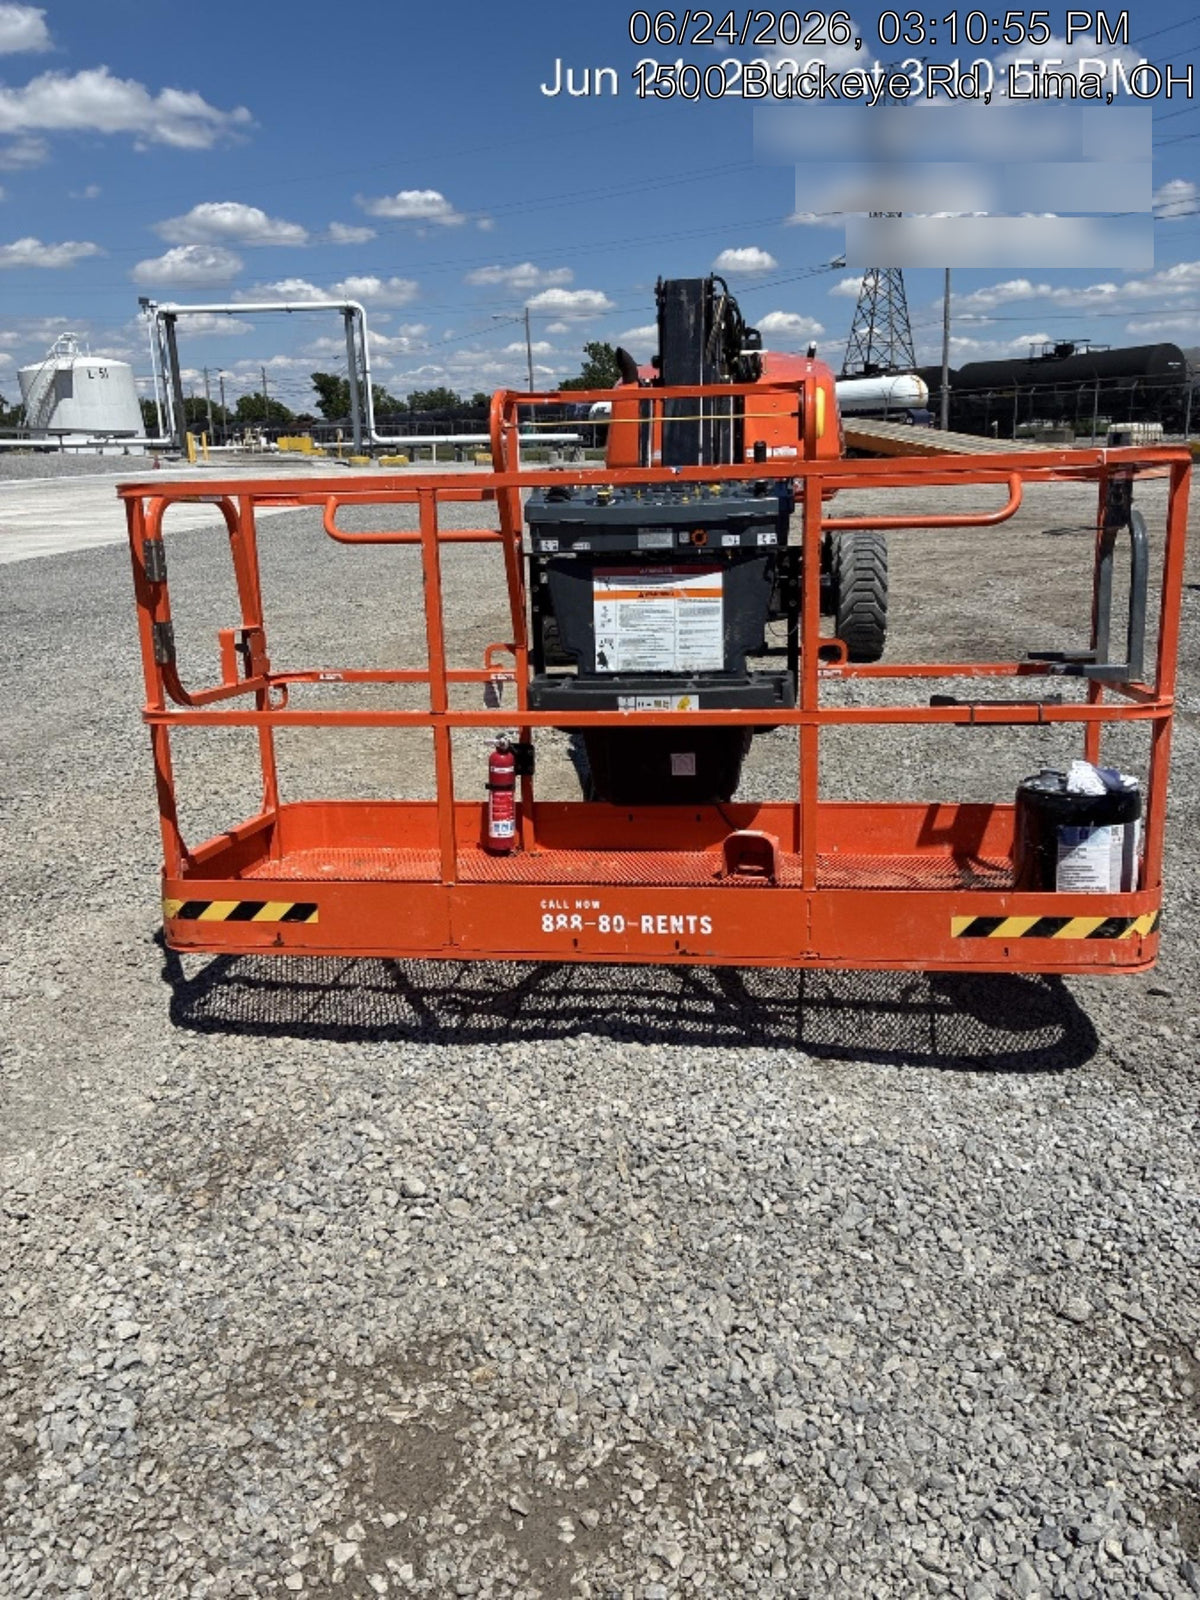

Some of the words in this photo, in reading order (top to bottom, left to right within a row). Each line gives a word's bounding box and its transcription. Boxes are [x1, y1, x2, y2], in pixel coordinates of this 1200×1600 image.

[540, 899, 570, 909] CALL
[575, 899, 601, 909] NOW
[541, 913, 713, 935] 888-80-RENTS
